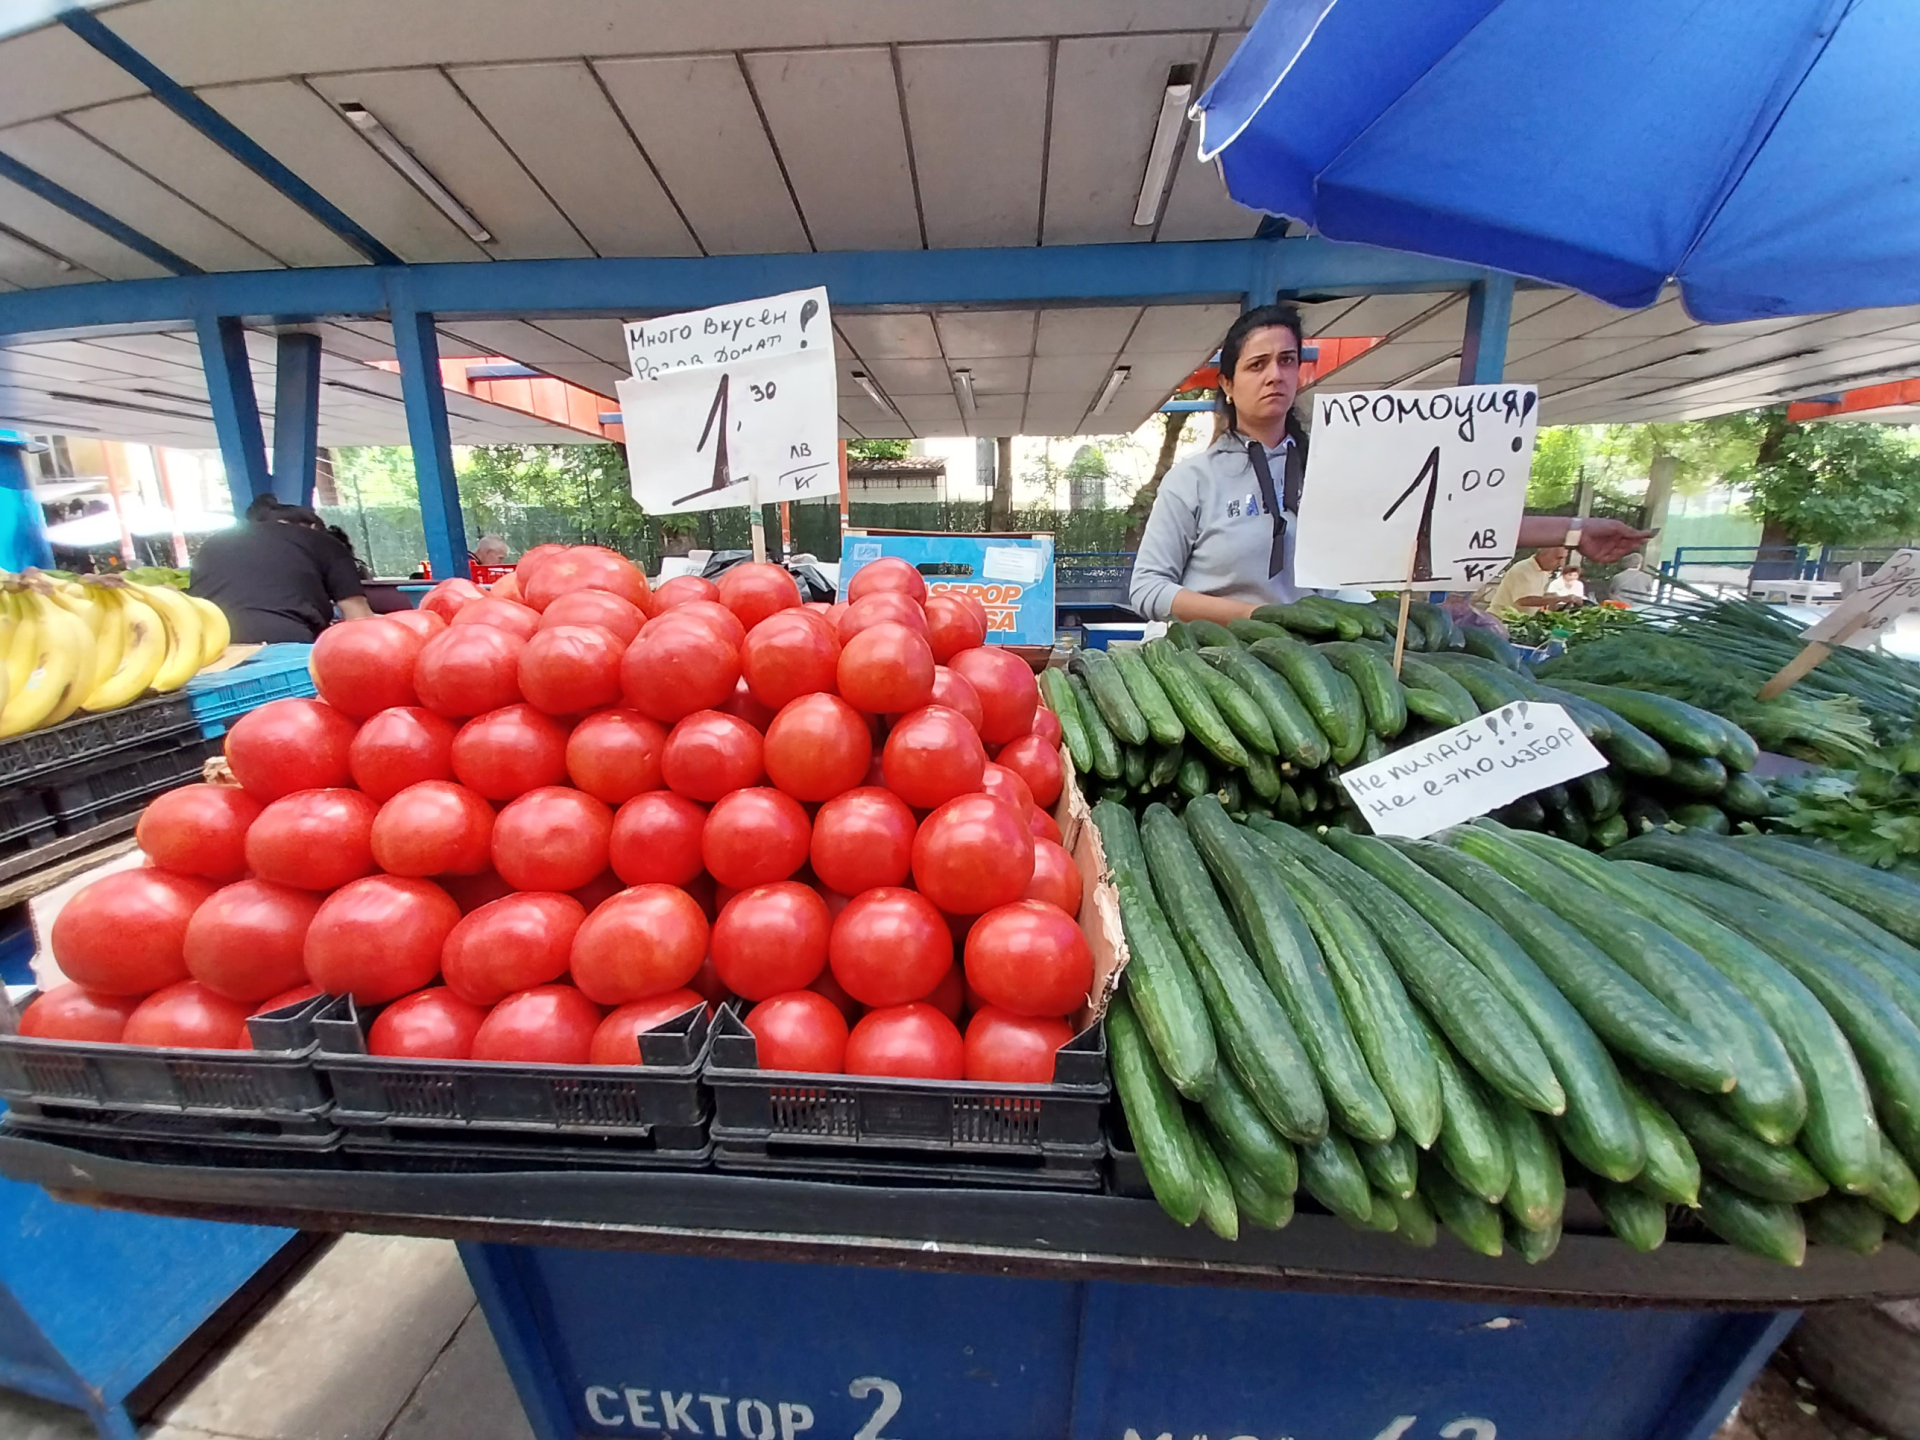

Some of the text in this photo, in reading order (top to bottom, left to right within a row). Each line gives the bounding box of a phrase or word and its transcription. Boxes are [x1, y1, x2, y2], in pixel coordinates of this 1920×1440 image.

[629, 325, 692, 350] Много
[1350, 774, 1387, 796] Не
[1369, 795, 1416, 817] Не
[585, 1376, 902, 1440] СЕКТОР 2
